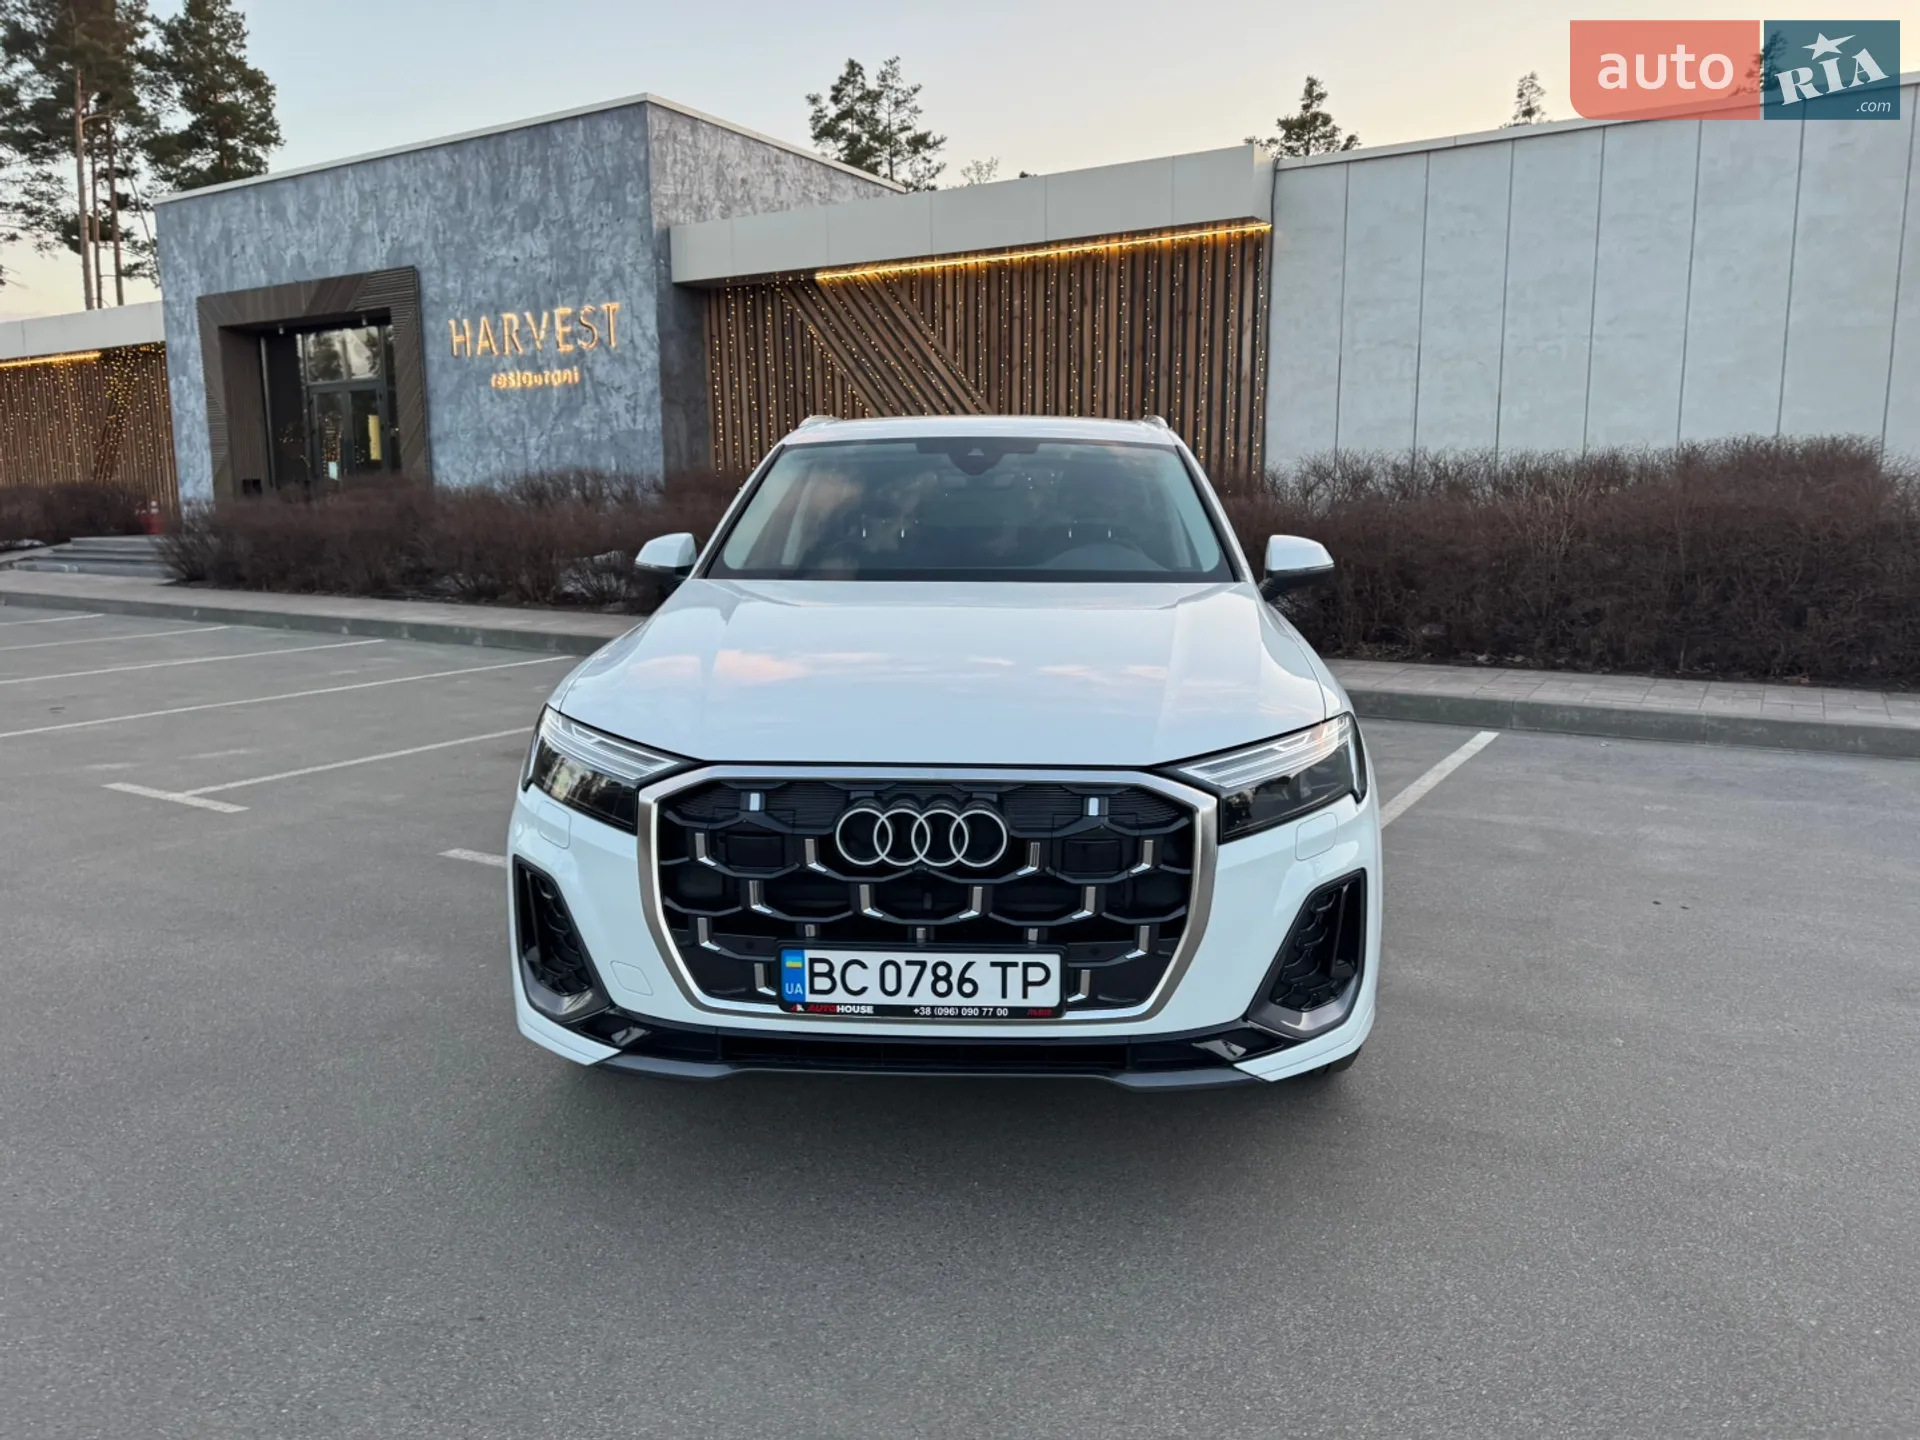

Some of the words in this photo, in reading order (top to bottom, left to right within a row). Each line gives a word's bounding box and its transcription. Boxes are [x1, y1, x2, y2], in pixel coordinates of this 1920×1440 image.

[448, 302, 621, 357] HARVEST
[785, 982, 804, 995] UA
[808, 957, 869, 997] BC
[879, 959, 979, 998] 0786
[989, 961, 1051, 999] TP
[913, 1007, 931, 1016] +38
[961, 1007, 979, 1016] 090
[982, 1007, 994, 1016] 77
[996, 1008, 1009, 1017] 00
